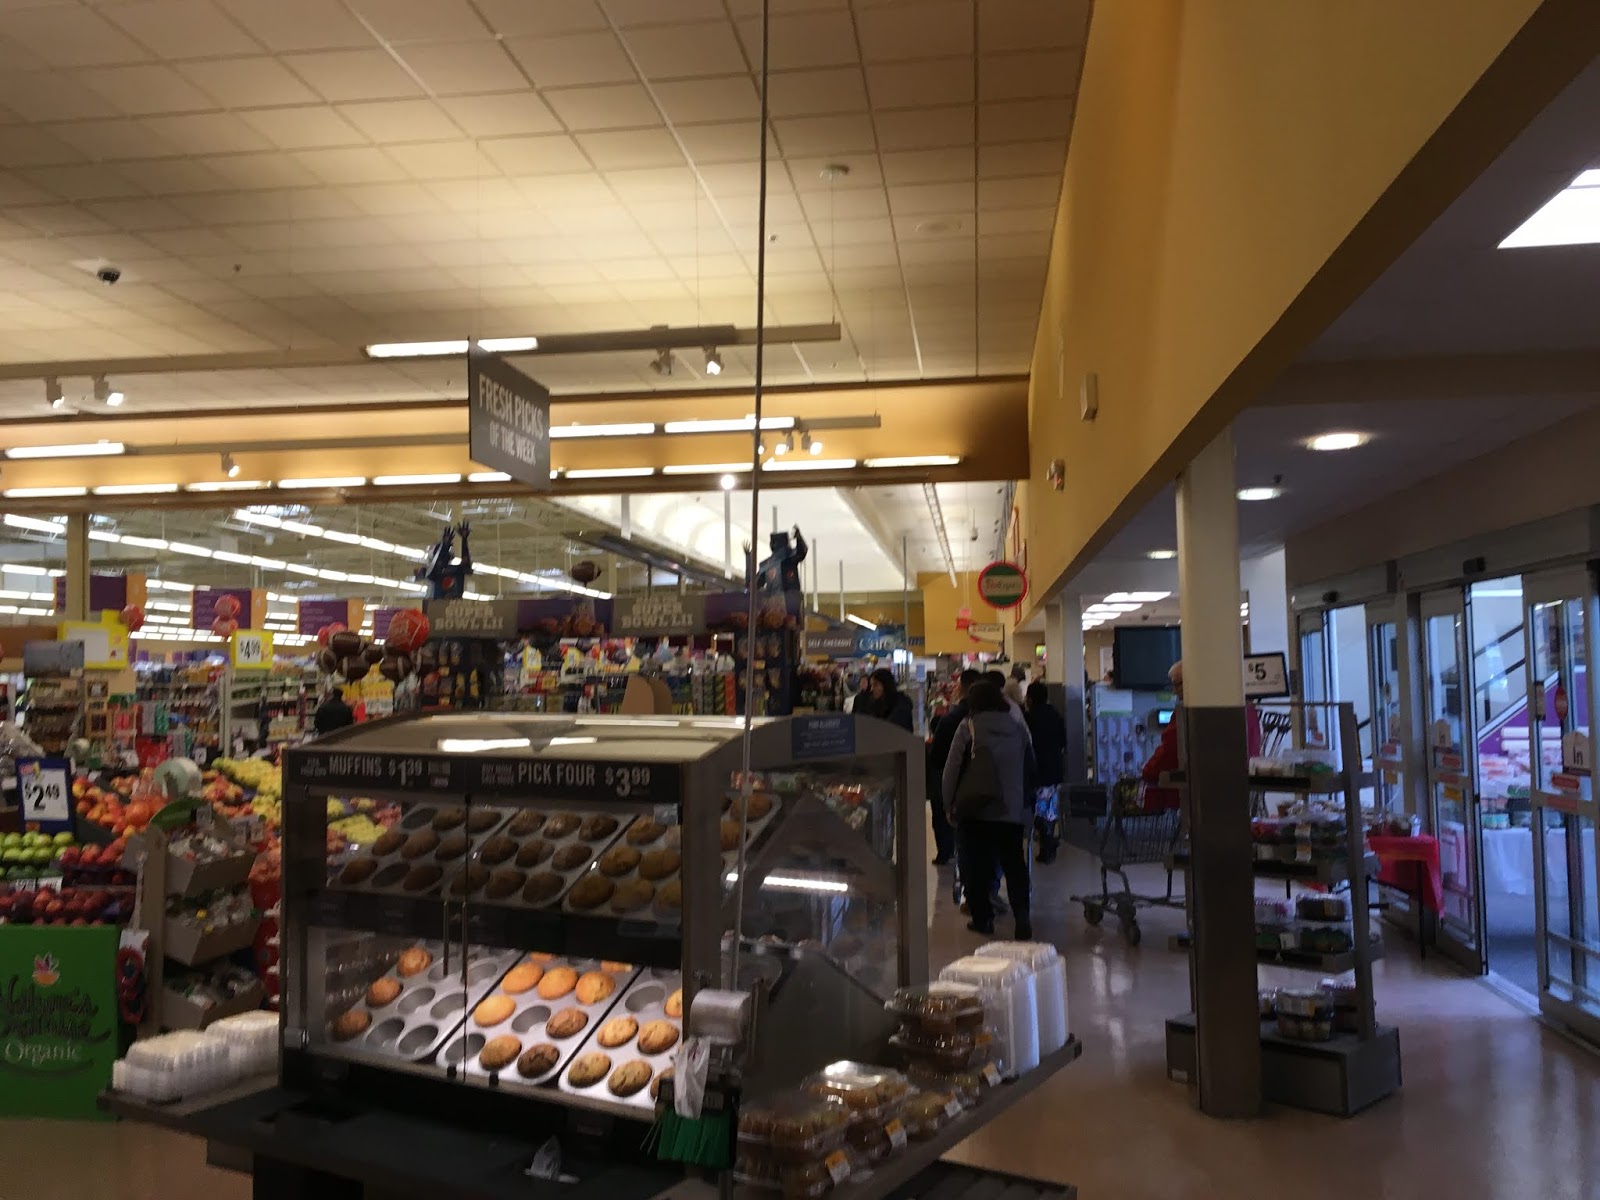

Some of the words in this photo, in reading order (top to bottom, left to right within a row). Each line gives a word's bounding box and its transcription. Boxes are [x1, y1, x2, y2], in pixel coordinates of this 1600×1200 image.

[478, 372, 513, 425] FRESH
[514, 394, 544, 441] PICKS
[489, 419, 500, 448] OF
[500, 425, 516, 457] THE
[515, 433, 537, 467] WEEK
[445, 606, 494, 617] SUPER
[632, 602, 683, 616] SUPER
[434, 617, 480, 630] BOWL
[482, 616, 504, 630] LII
[621, 615, 669, 629] BOWL
[671, 613, 694, 627] LII
[1248, 662, 1267, 681] $5
[1572, 745, 1584, 765] In
[329, 754, 382, 778] MUFFINS
[517, 761, 552, 786] PICK
[556, 763, 596, 787] FOUR
[4, 1040, 82, 1068] Organic
